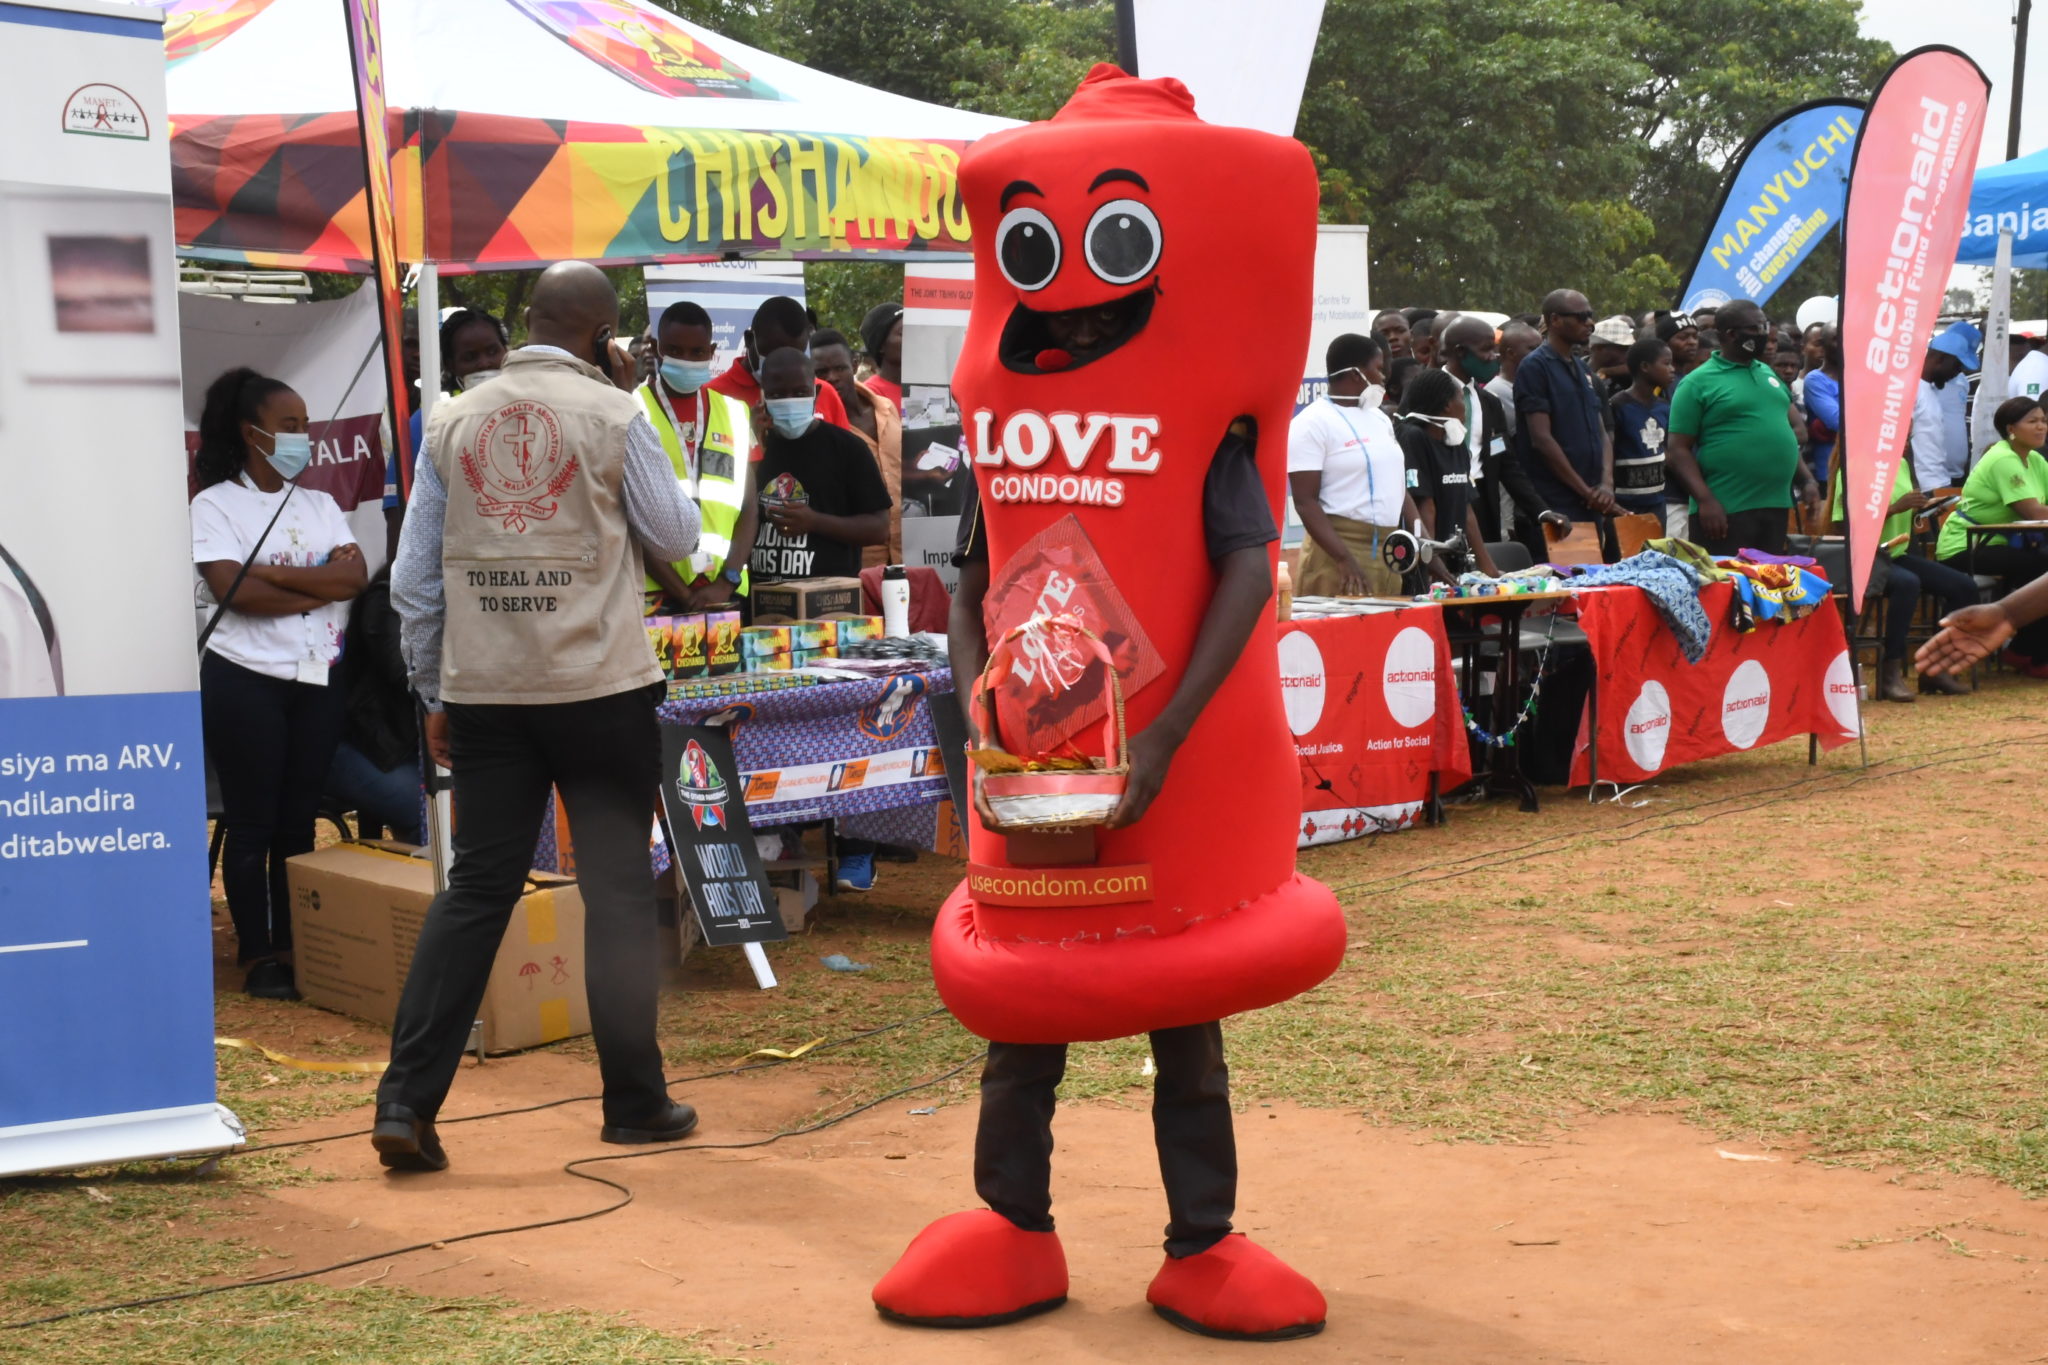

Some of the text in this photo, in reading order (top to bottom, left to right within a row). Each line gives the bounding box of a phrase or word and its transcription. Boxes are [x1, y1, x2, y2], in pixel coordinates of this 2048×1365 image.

[1711, 115, 1855, 270] MANYUCHI
[1749, 213, 1802, 273] changes
[1759, 208, 1829, 284] everything
[1866, 101, 1967, 520] Joint TB/HIV Global Fund Pgramme
[308, 434, 372, 467] TALA
[478, 404, 559, 468] CHRISTIAN HEALTH ASSOCIATION
[973, 410, 1161, 473] LOVE
[504, 480, 534, 491] MALAWI
[990, 476, 1124, 505] CONDOMS
[781, 549, 815, 575] DAY
[467, 571, 572, 586] TO HEAL AND
[480, 596, 557, 612] TO SERVE
[1280, 674, 1321, 688] ctionaid
[1294, 745, 1317, 756] Social
[1366, 735, 1431, 750] Action for Social
[1, 743, 181, 782] siya ma ARV,
[1, 827, 171, 859] ditabwelera.
[694, 843, 748, 879] WORLD
[702, 880, 766, 918] AIDS DAY
[970, 873, 1147, 897] usecondom.com
